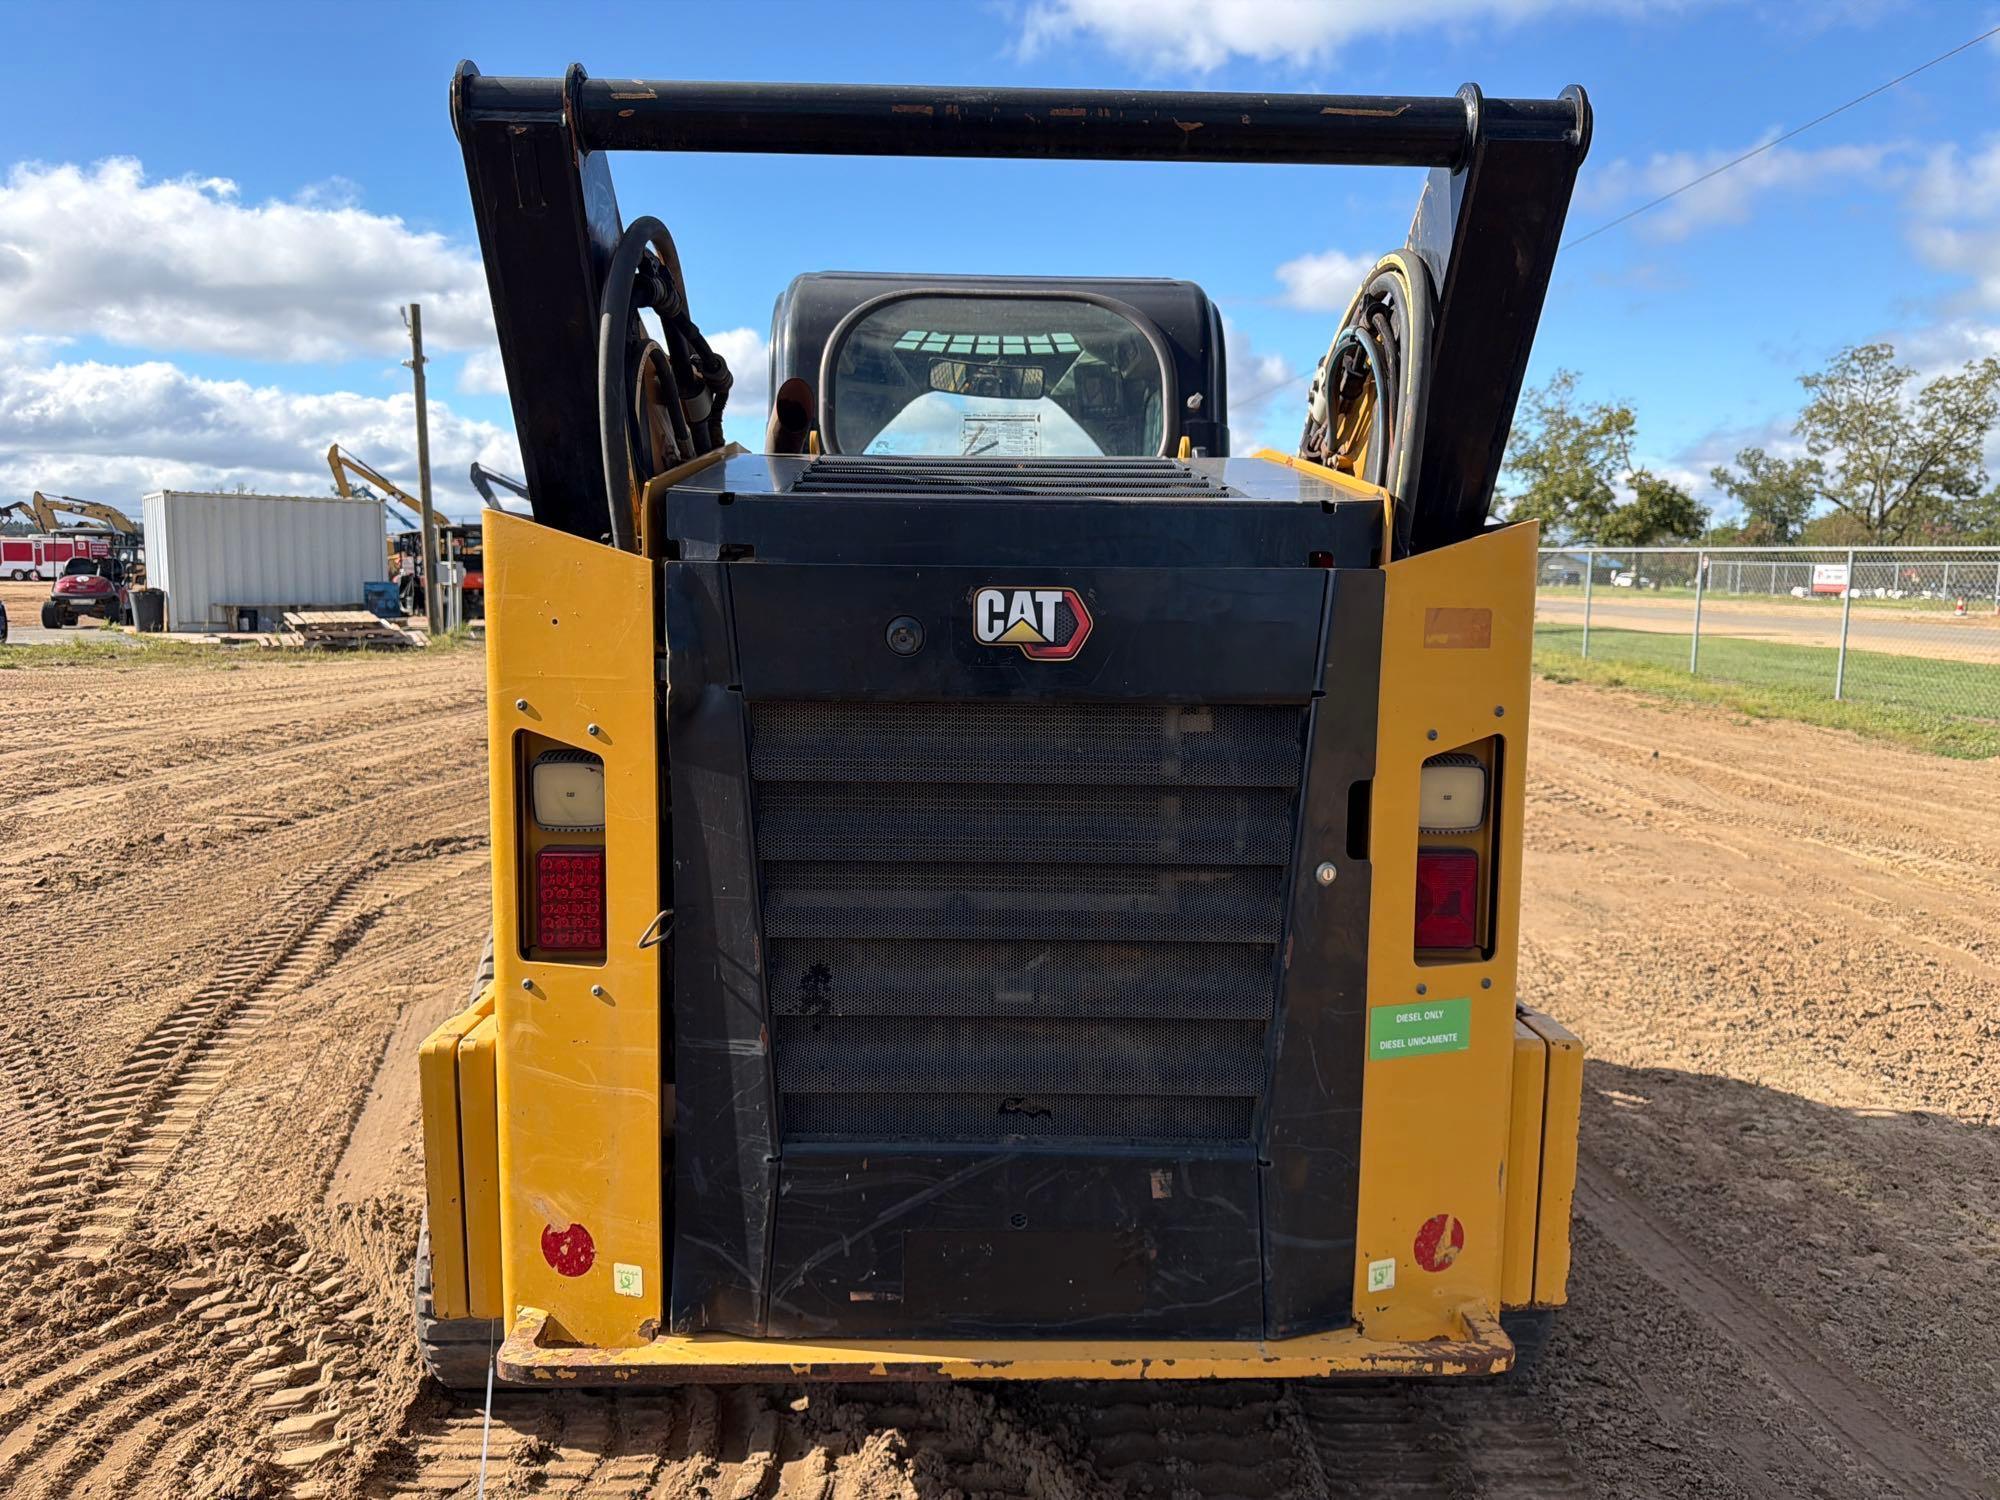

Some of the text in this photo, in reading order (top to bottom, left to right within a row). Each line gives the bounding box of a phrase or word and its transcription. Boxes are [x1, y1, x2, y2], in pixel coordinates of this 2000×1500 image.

[977, 589, 1063, 643] CAT
[1396, 1009, 1444, 1023] DIESEL ONLY
[1380, 1032, 1457, 1050] DIESEL UNICAMENTE
